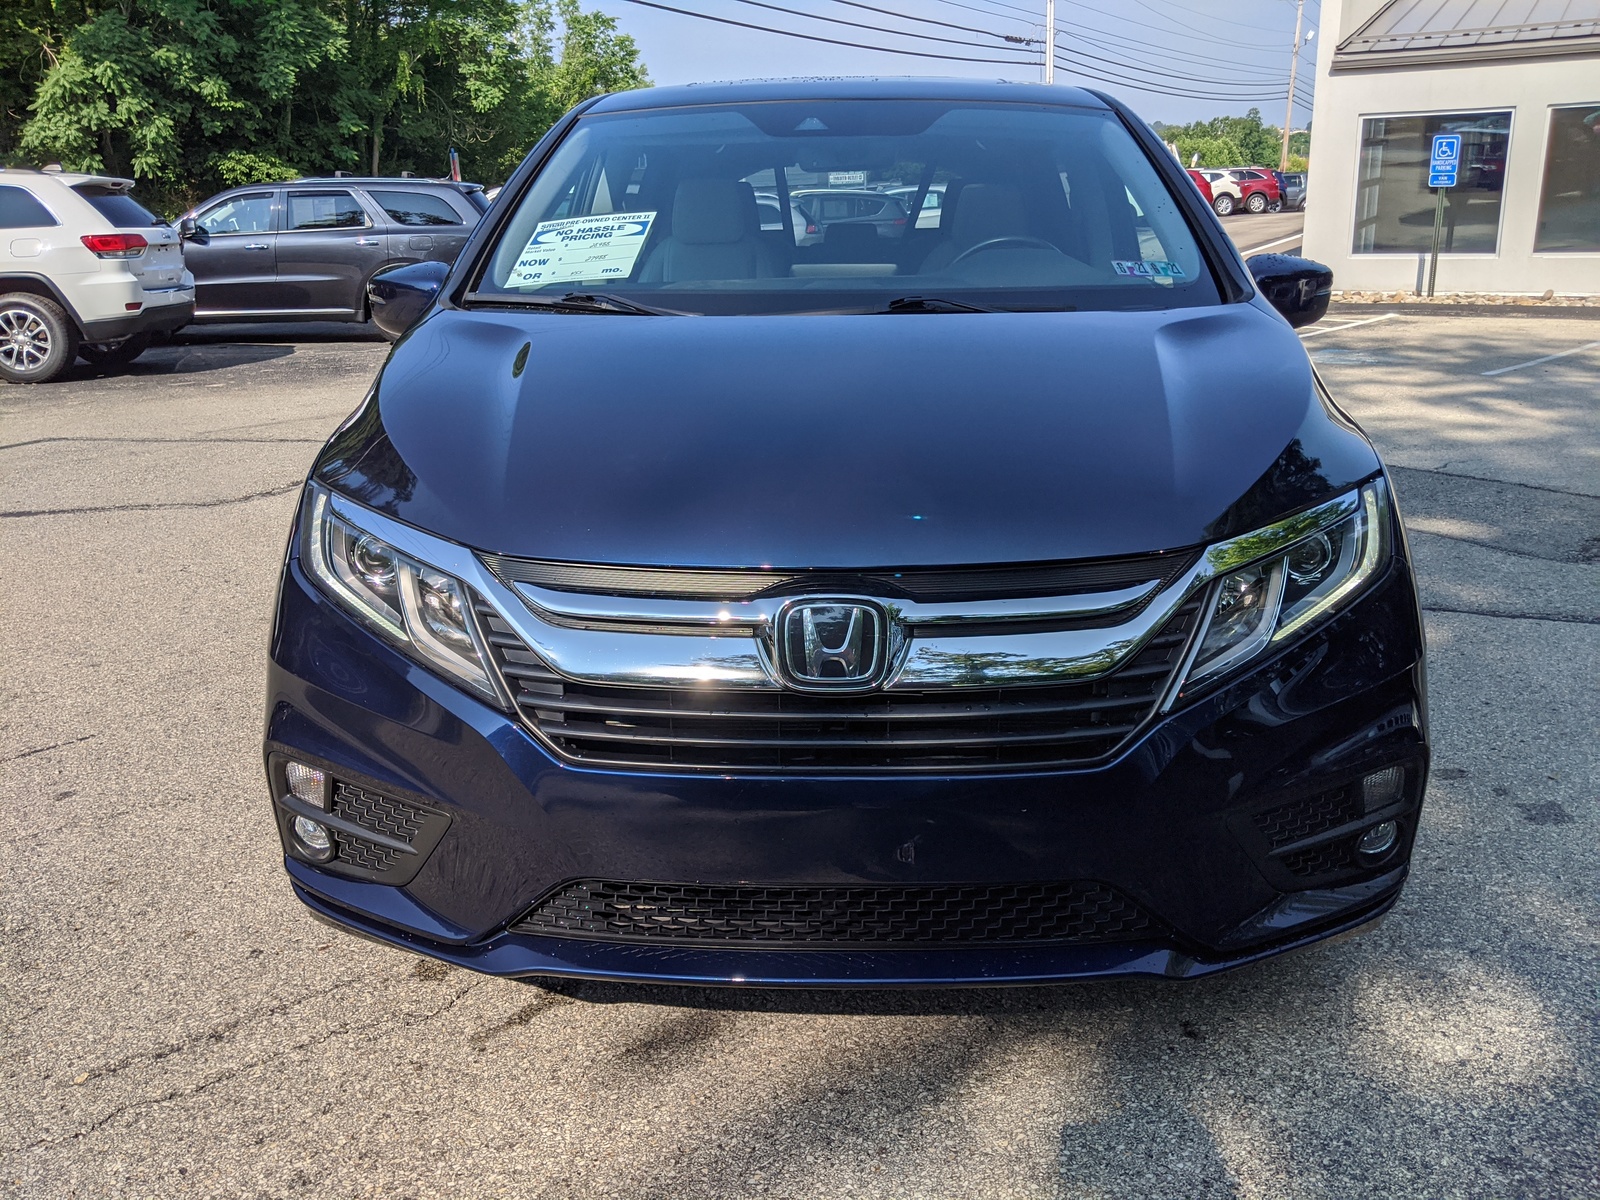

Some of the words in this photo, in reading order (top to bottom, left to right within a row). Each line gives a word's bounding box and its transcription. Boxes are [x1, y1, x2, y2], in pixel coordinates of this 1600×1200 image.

[565, 217, 610, 225] PRE-OWNED
[555, 229, 574, 237] NO
[575, 225, 626, 234] HASSLE
[561, 232, 613, 242] PRICING
[518, 258, 550, 267] NOW
[522, 272, 542, 280] OR
